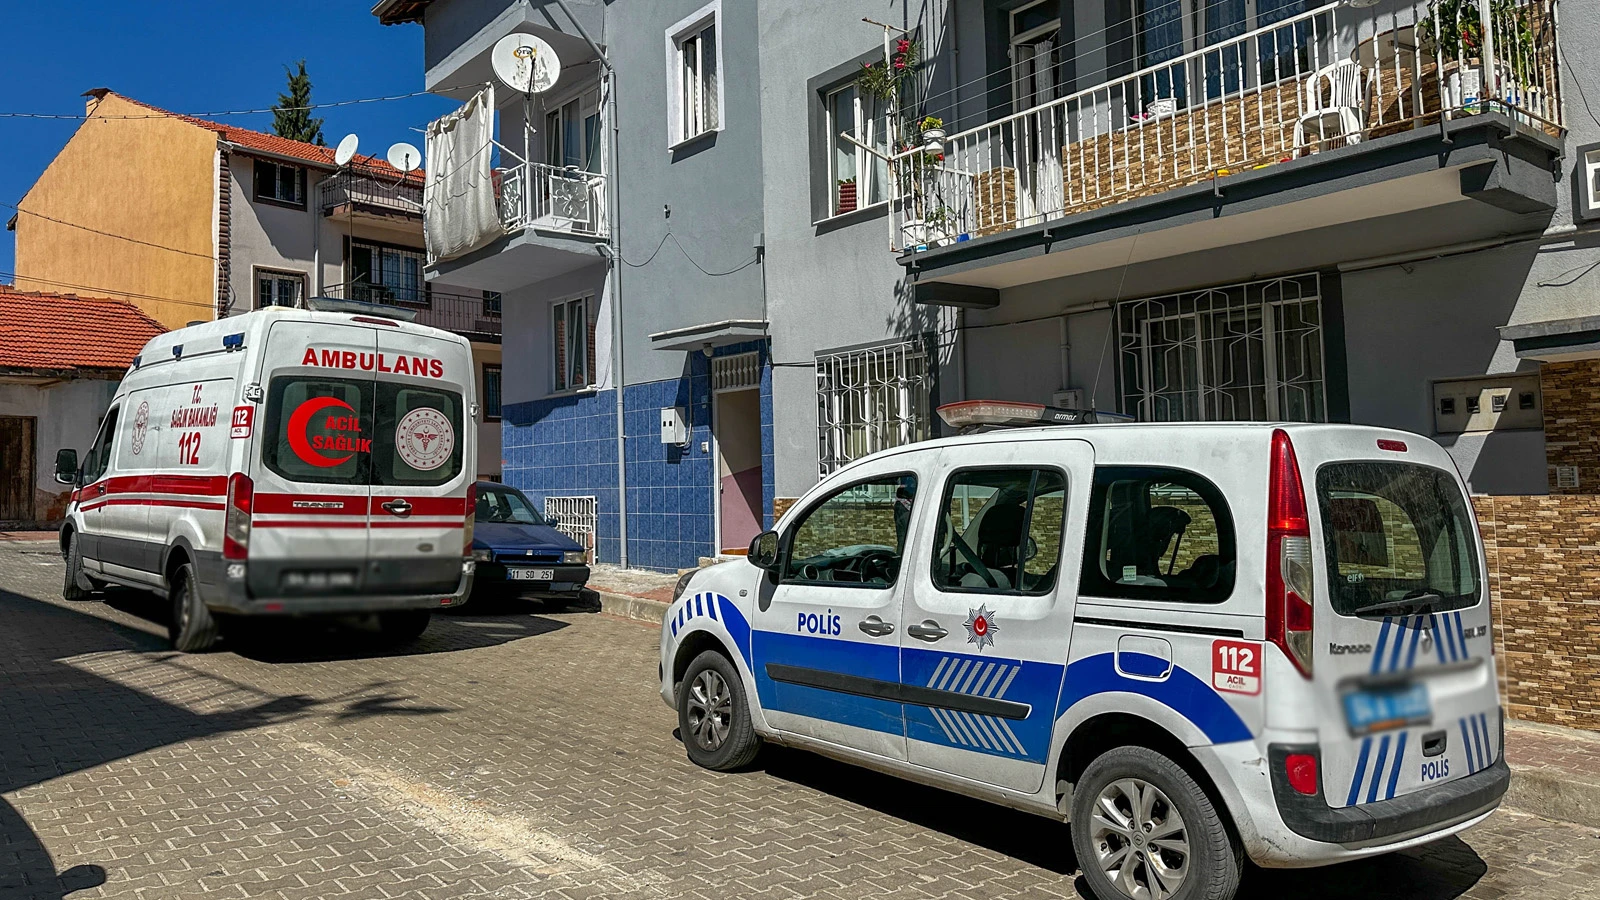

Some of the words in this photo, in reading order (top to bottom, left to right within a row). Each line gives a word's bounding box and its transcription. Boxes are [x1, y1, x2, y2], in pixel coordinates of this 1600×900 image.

[302, 348, 444, 378] AMBULANS
[234, 410, 248, 425] 112
[325, 413, 361, 432] ACİL
[178, 432, 201, 464] 112
[312, 434, 372, 453] SAĞLIK
[541, 570, 553, 579] 251
[797, 608, 841, 636] POLİS
[1219, 645, 1254, 673] 112
[1421, 754, 1449, 782] POLİS
